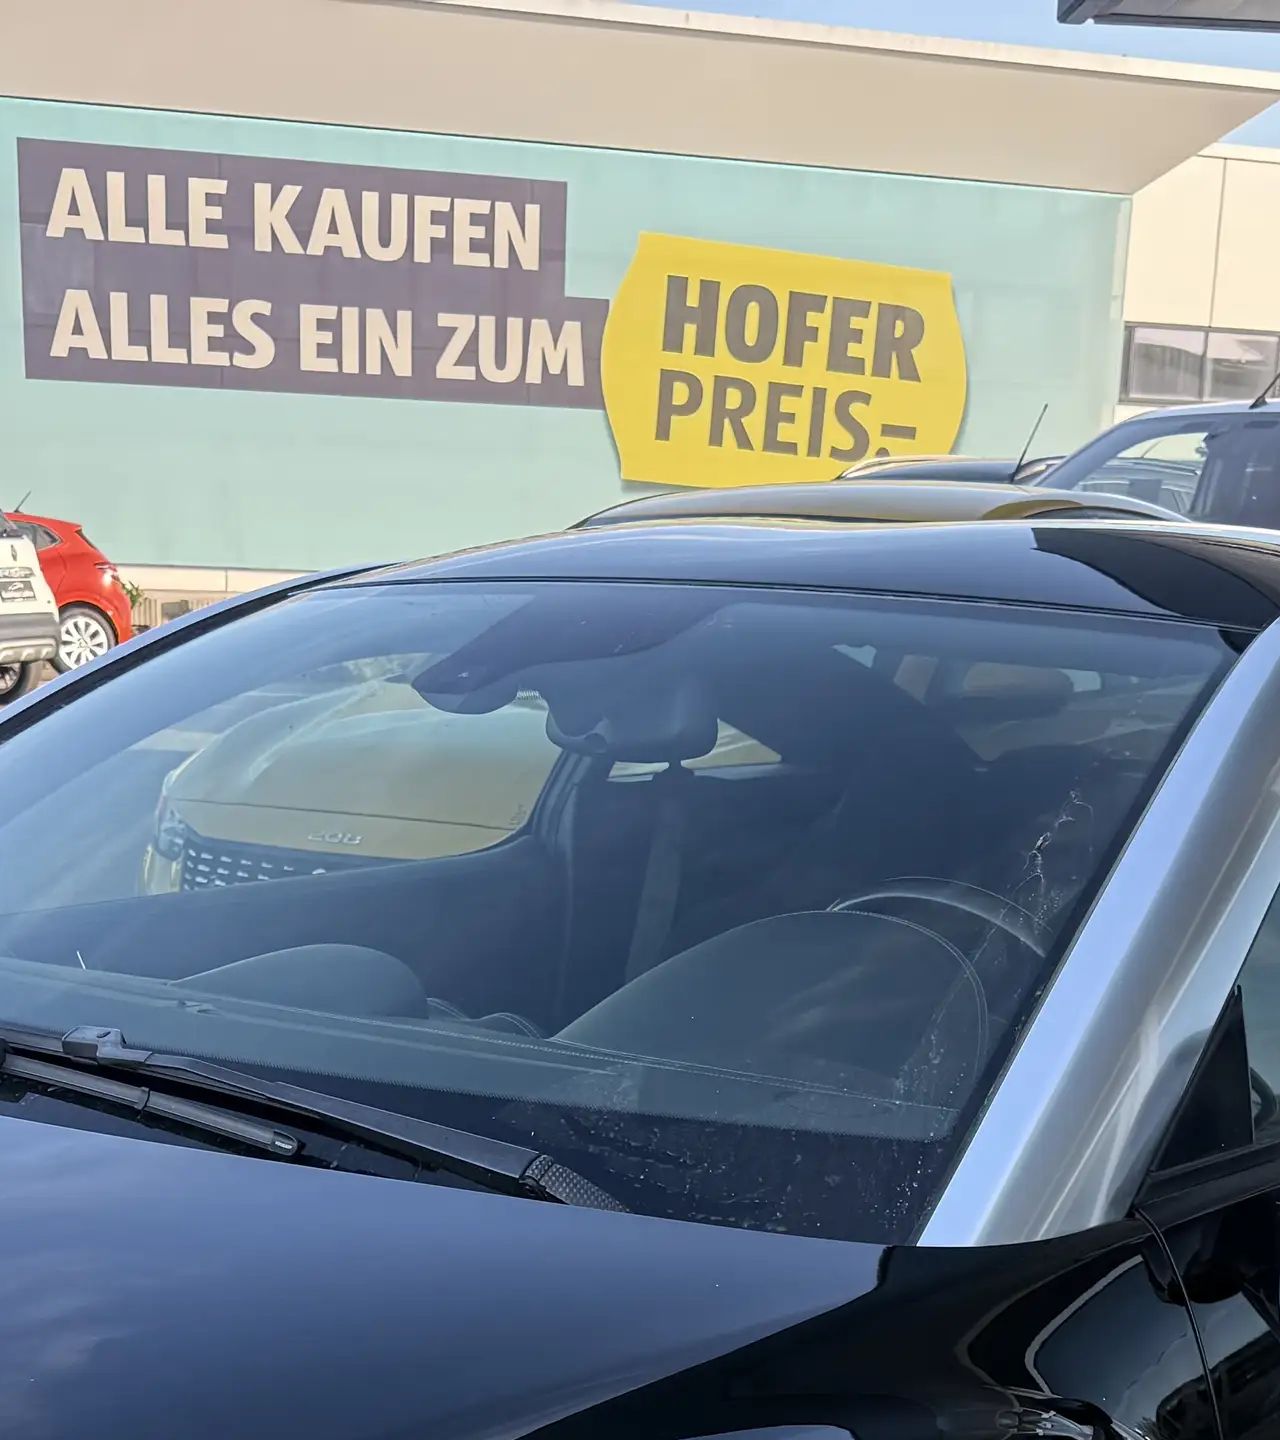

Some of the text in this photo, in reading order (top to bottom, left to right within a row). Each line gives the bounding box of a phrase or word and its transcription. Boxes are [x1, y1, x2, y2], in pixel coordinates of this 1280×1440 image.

[45, 167, 541, 271] ALLE KAUFEN
[49, 288, 585, 387] ALLES EIN ZUM
[662, 274, 925, 383] HOFER
[655, 368, 917, 463] PREIS.-
